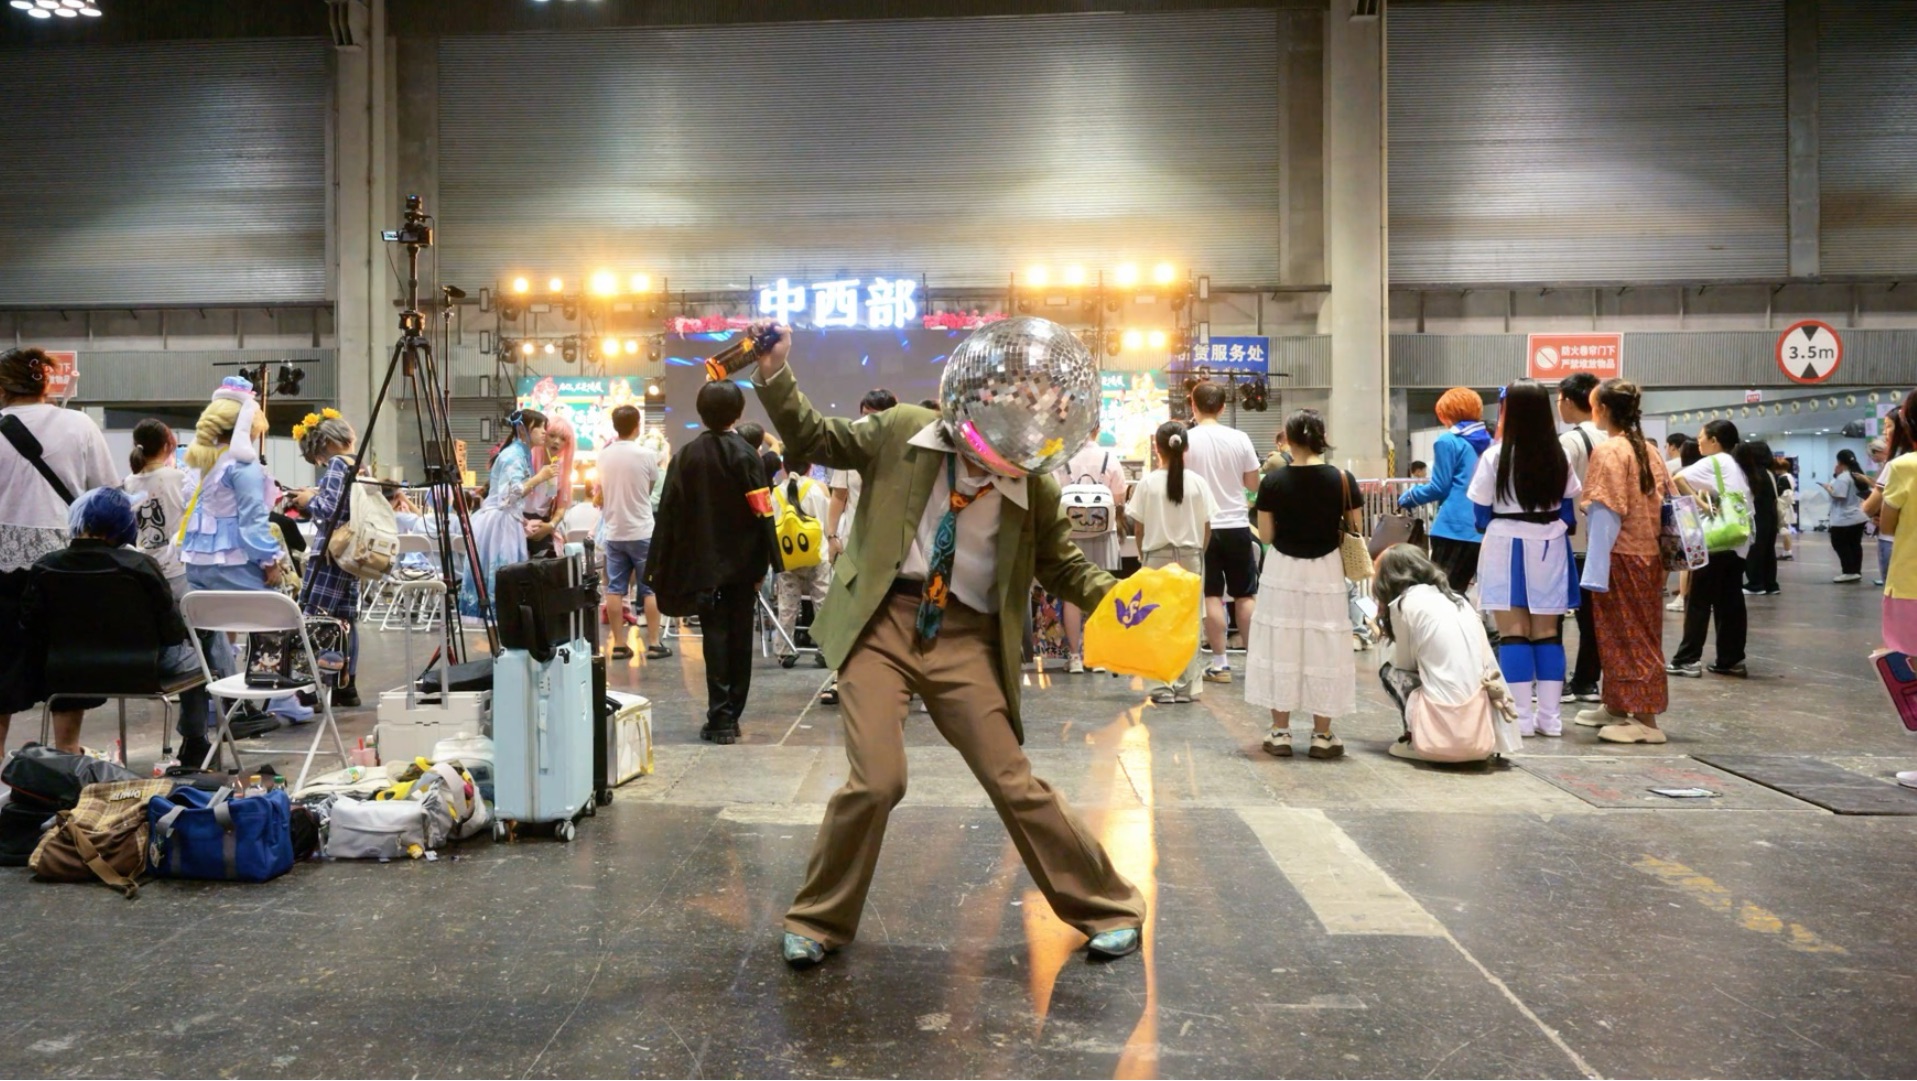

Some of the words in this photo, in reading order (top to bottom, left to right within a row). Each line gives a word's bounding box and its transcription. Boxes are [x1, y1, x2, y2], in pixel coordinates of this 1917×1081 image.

[759, 277, 917, 328] 中西部
[1789, 345, 1834, 359] 3.5m
